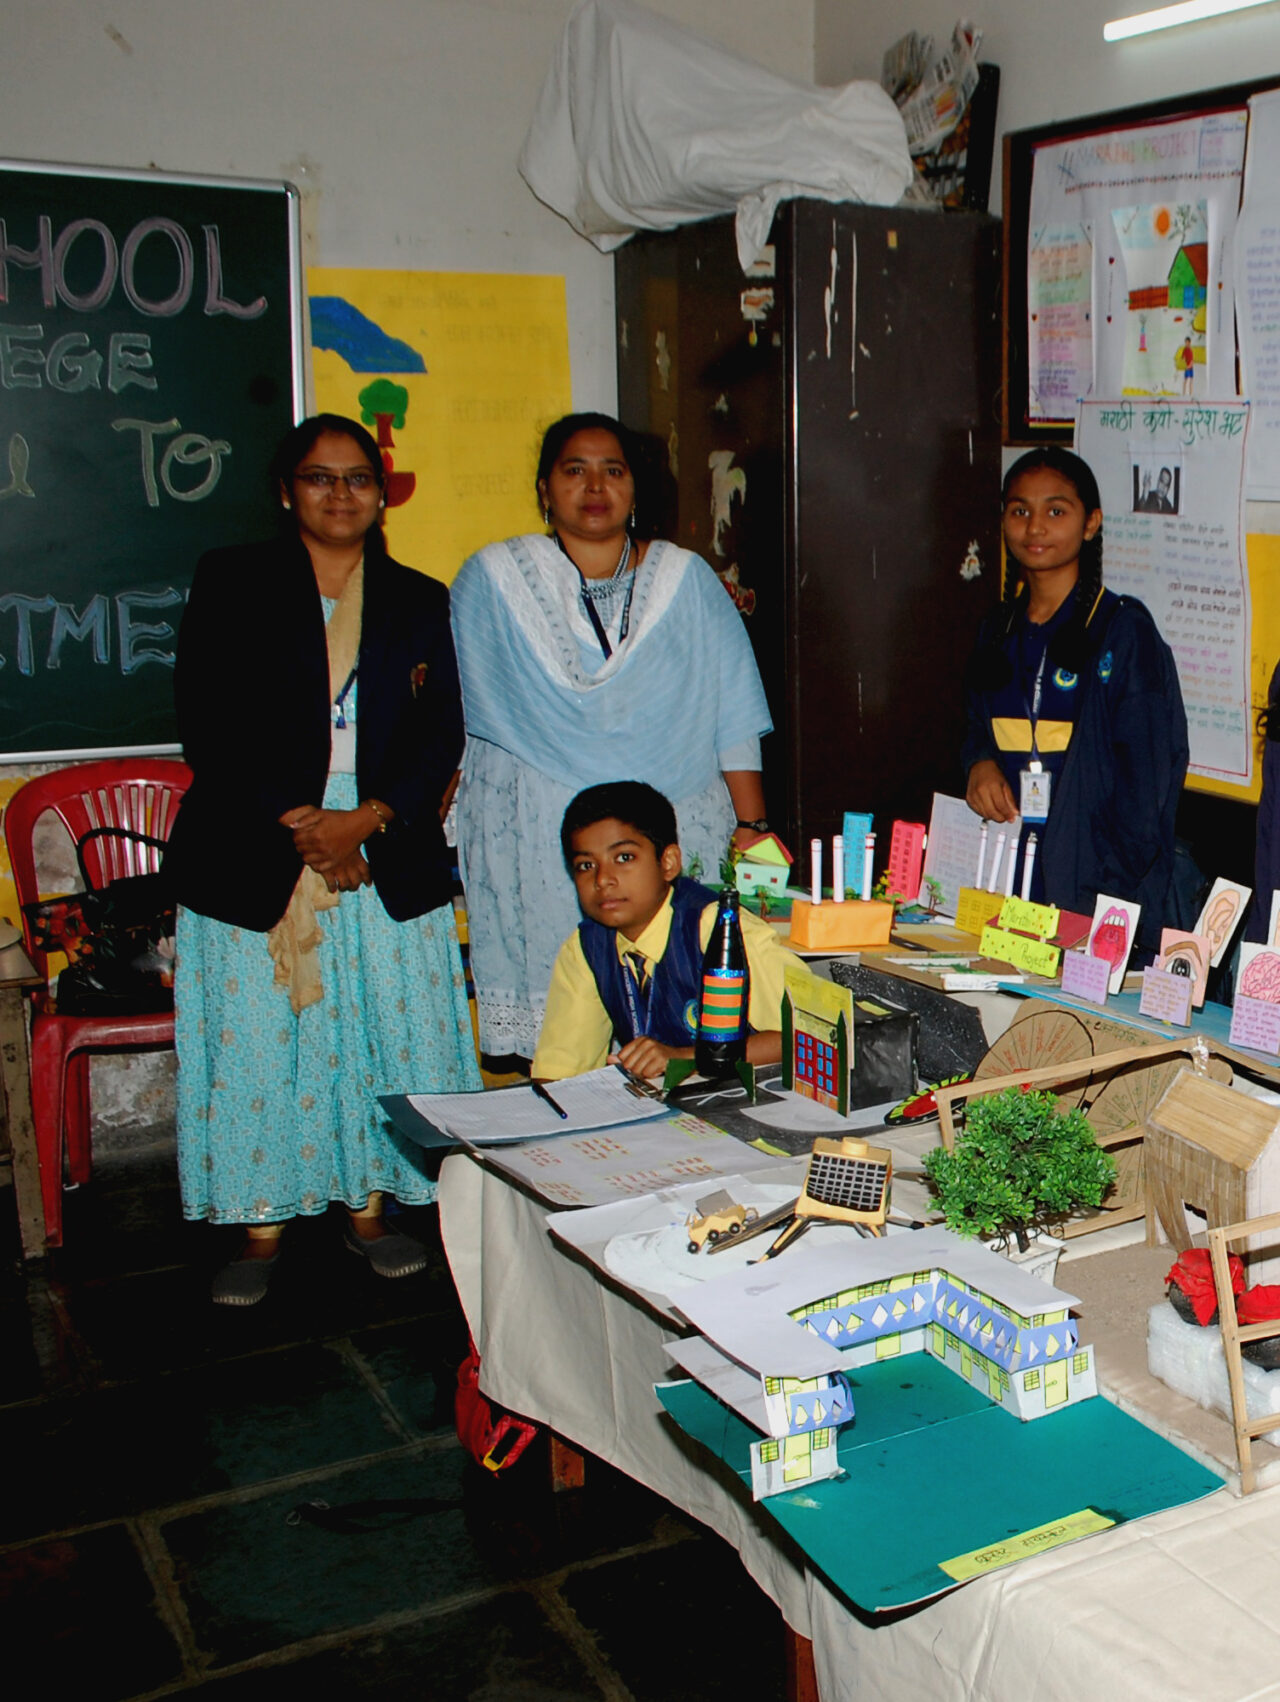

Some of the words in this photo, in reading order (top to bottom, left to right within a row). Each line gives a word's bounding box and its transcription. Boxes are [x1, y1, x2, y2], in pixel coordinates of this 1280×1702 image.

[1100, 399, 1137, 432] मराठी
[111, 416, 233, 507] TO
[0, 586, 190, 677] TME
